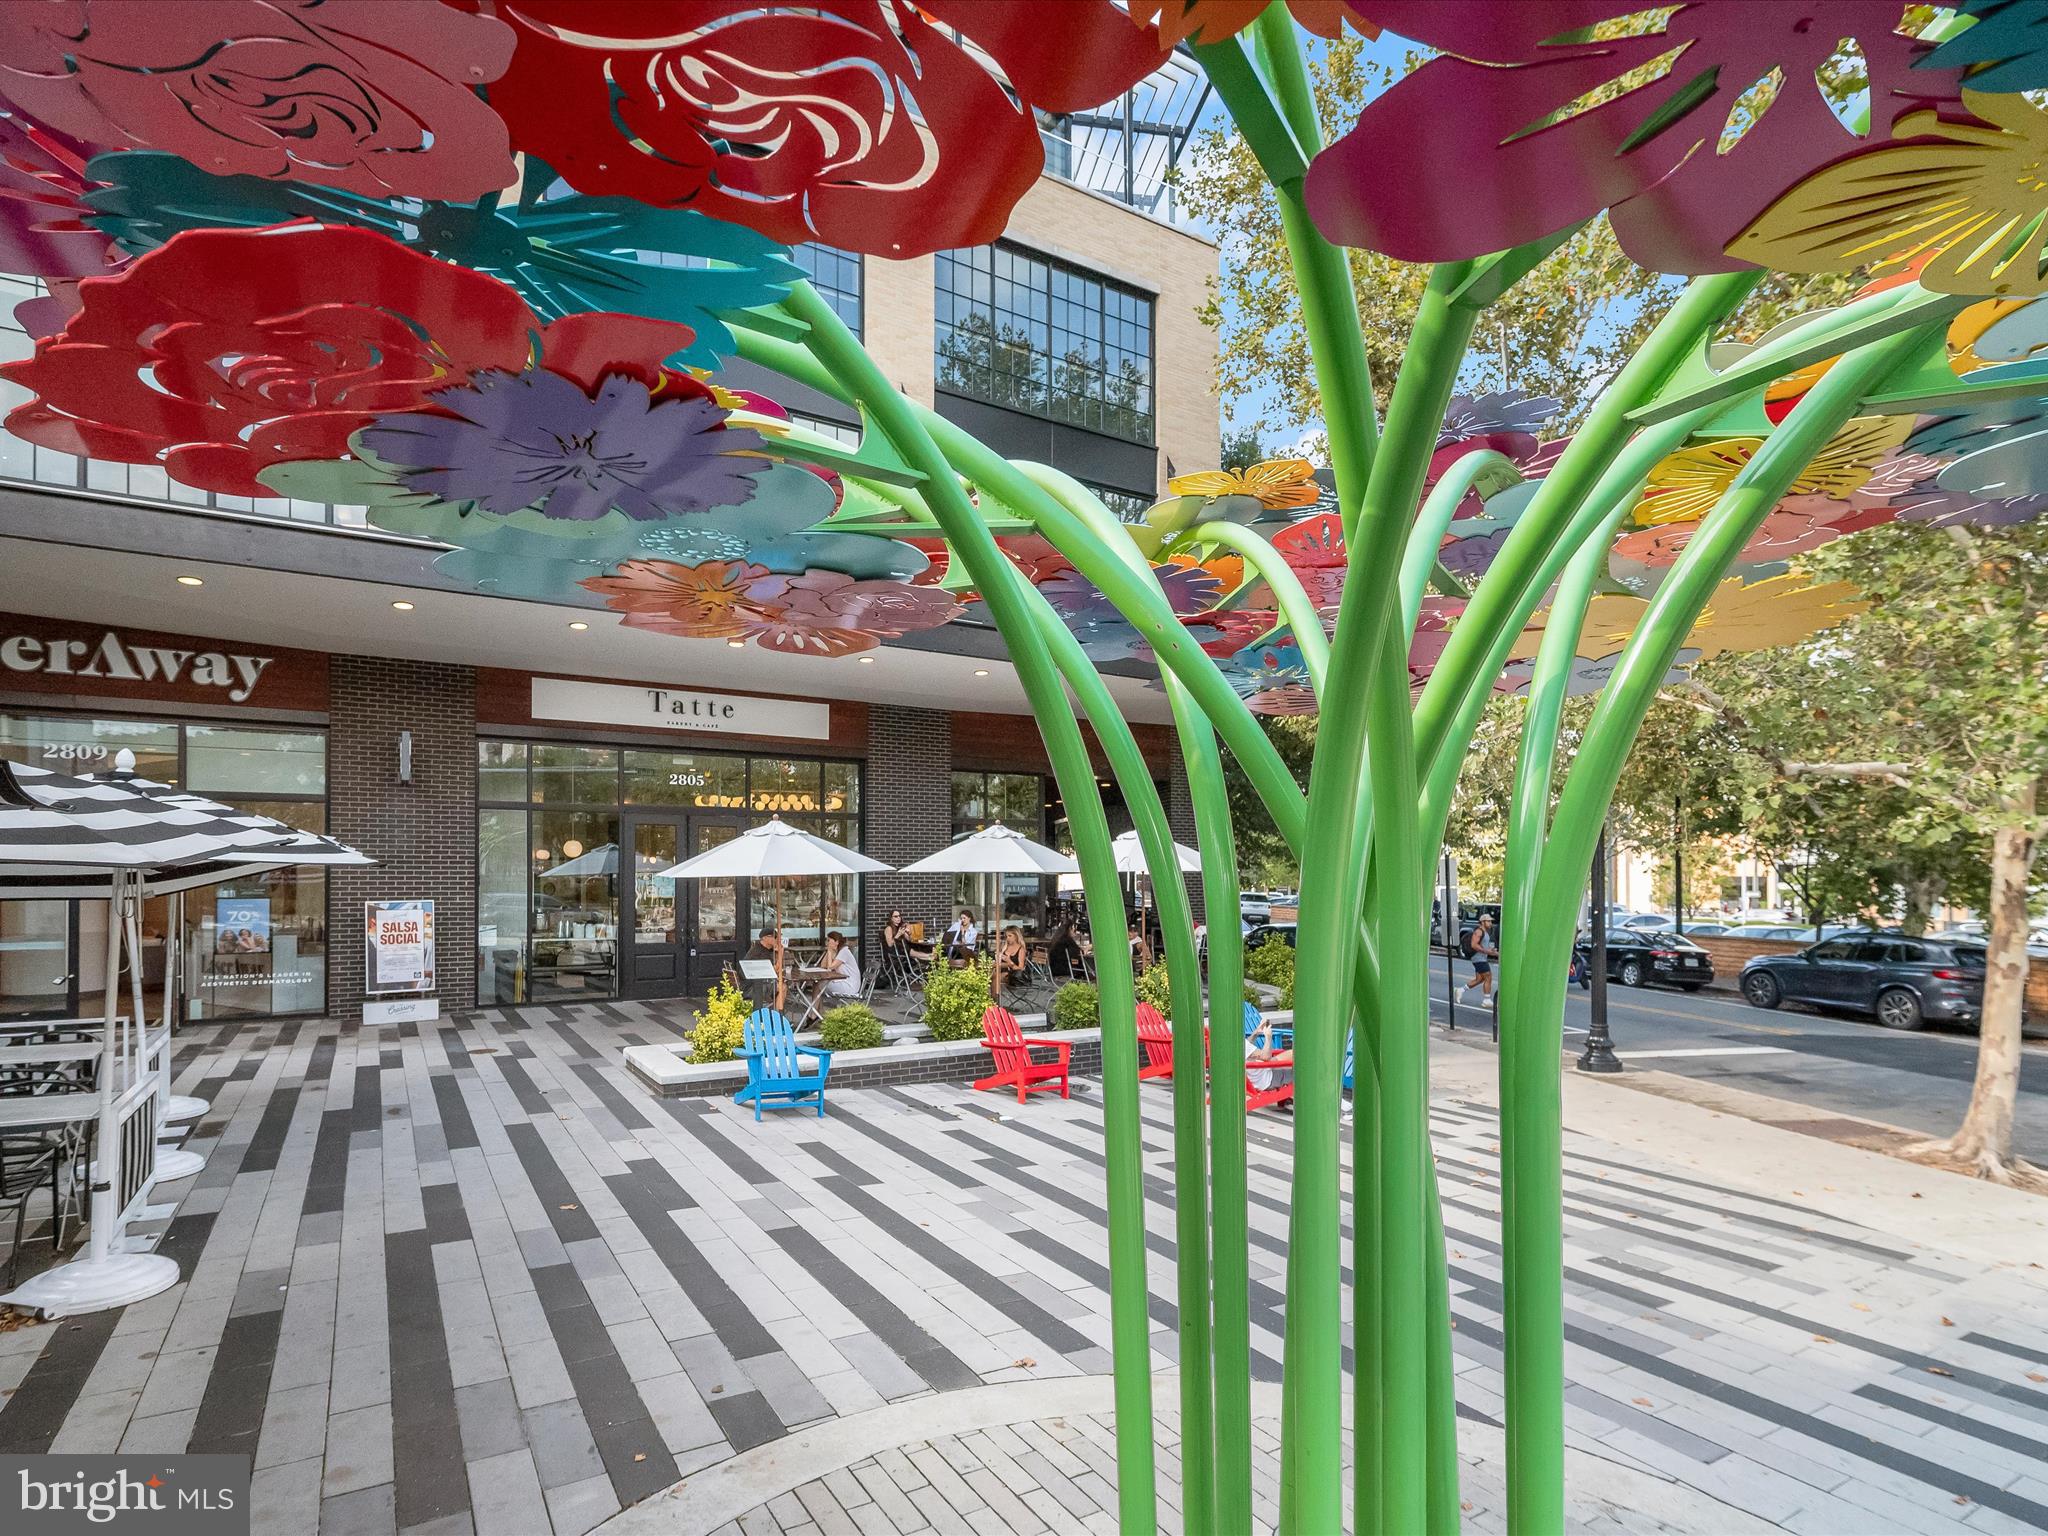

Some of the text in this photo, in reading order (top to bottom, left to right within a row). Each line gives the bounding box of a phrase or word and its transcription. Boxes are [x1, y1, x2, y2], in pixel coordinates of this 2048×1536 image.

[647, 690, 735, 719] Tatte
[43, 743, 108, 760] 2809
[669, 773, 705, 786] 2805
[382, 921, 419, 934] SALSA
[380, 933, 421, 945] SOCIAL
